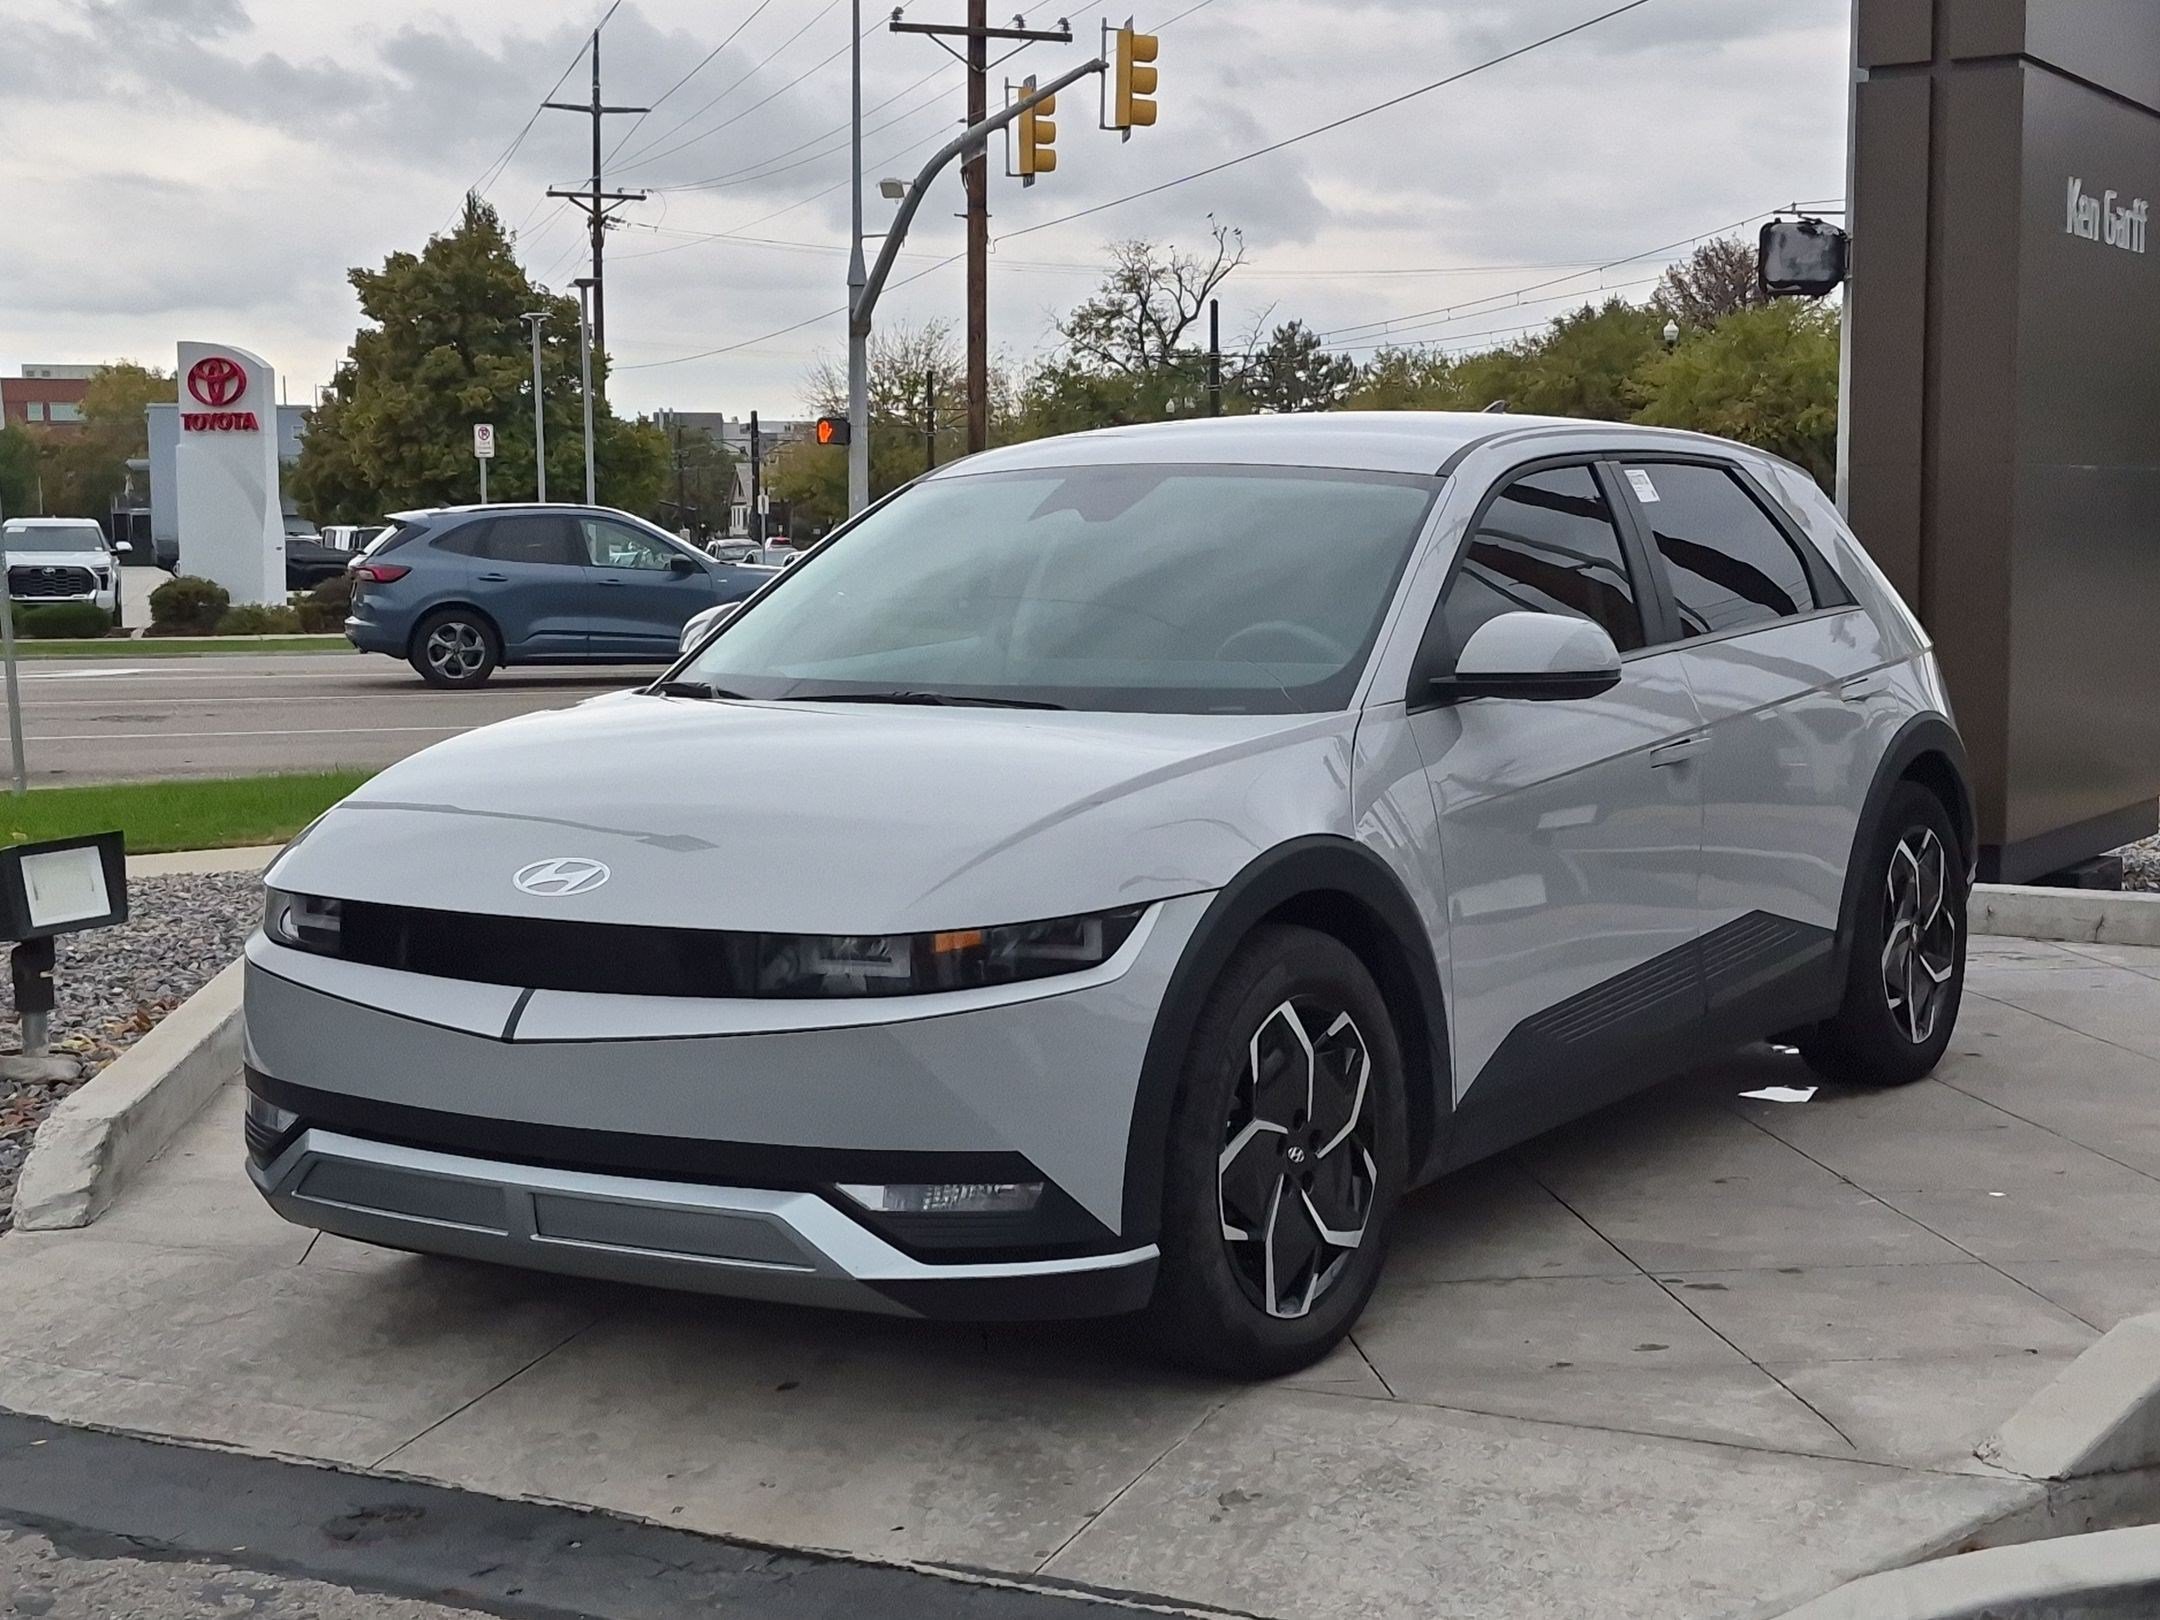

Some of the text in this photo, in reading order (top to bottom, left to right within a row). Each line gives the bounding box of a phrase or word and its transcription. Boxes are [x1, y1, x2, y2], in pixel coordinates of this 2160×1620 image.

[2066, 176, 2149, 253] Ken Garff
[180, 412, 259, 431] TOYOTA
